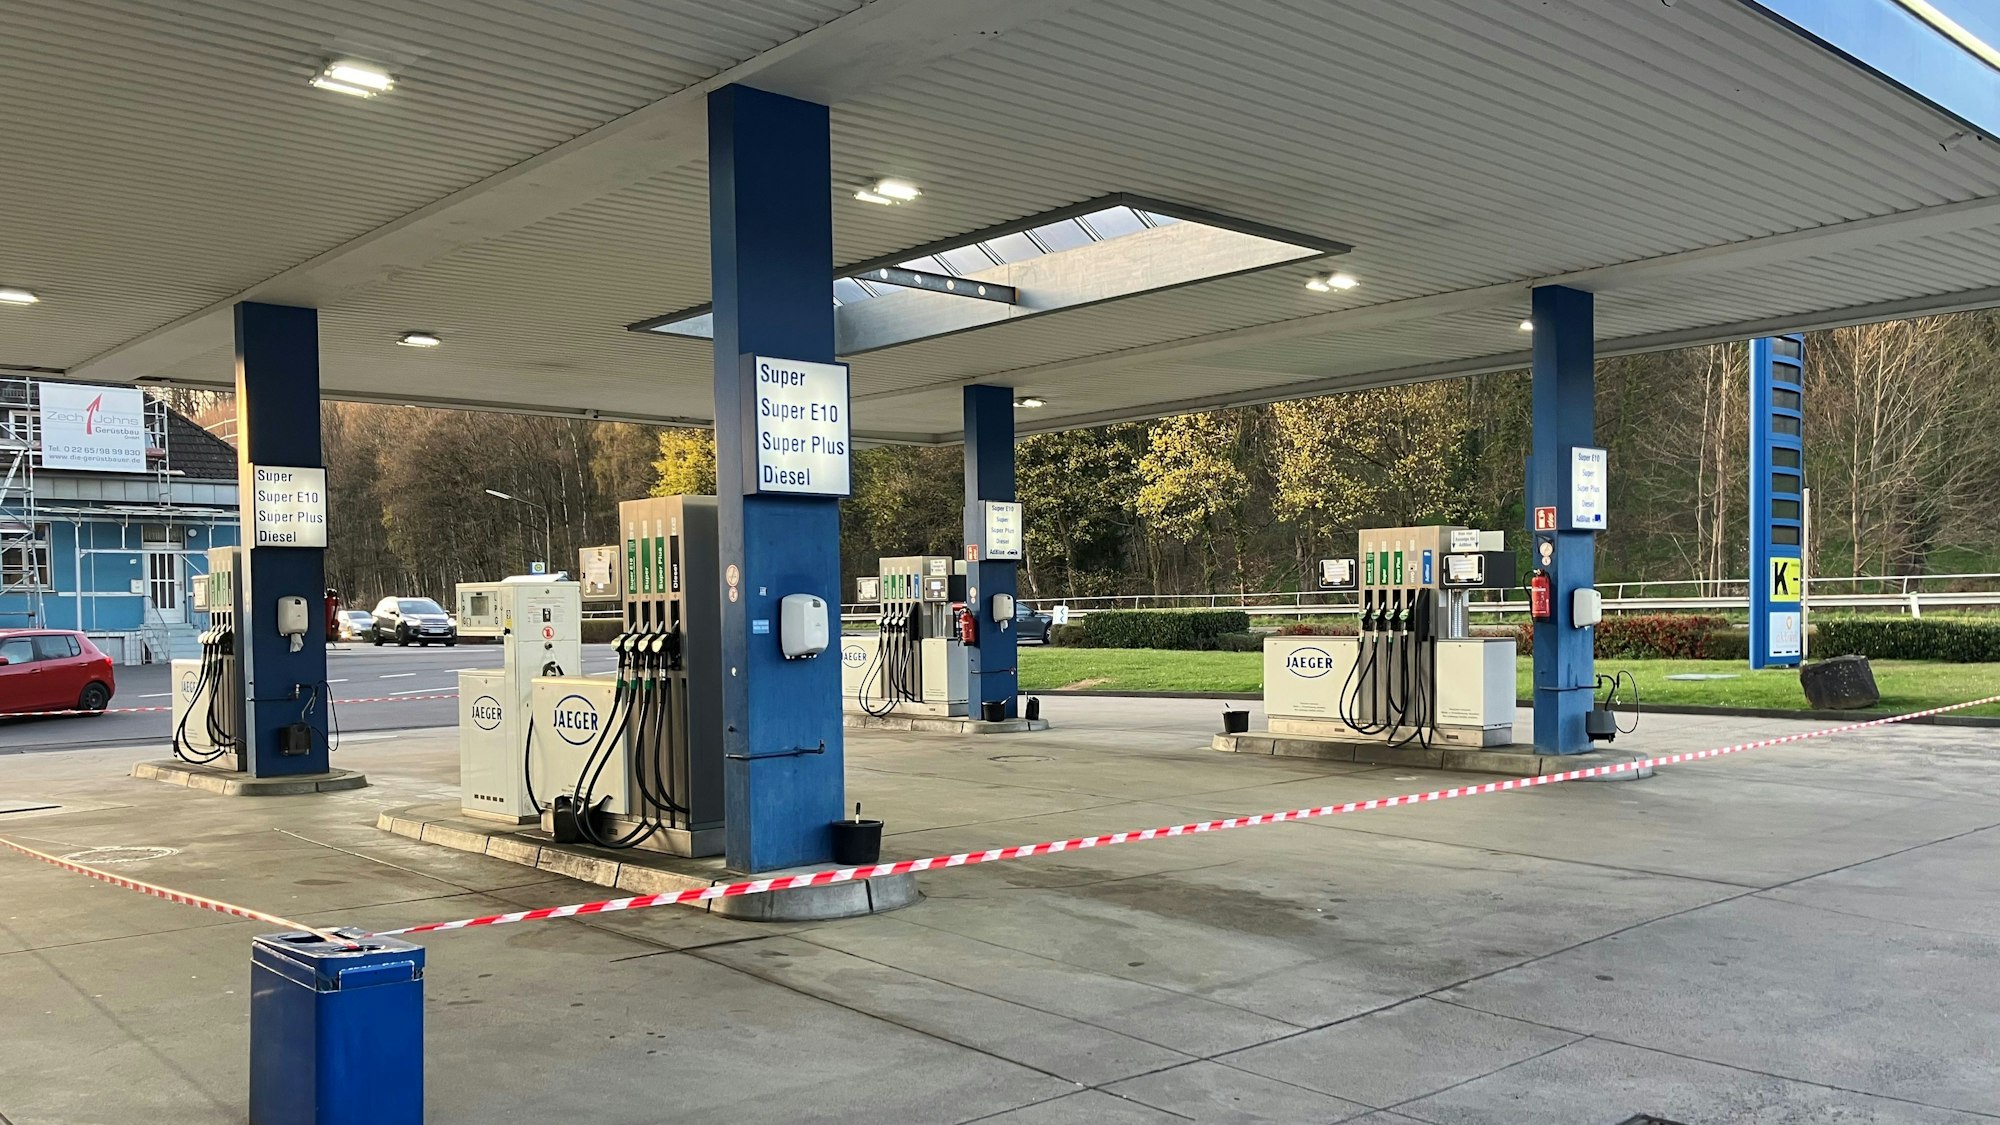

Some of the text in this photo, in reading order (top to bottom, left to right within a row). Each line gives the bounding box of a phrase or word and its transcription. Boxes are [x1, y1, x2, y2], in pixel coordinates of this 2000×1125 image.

[761, 364, 805, 388] Super
[762, 398, 838, 422] Super E10
[47, 411, 139, 425] Zech Johns
[96, 427, 139, 435] Gerüstbau
[762, 432, 844, 455] Super Plus
[258, 470, 292, 484] Super
[764, 465, 810, 485] Diesel
[258, 490, 318, 504] Super E10
[259, 510, 323, 524] Super Plus
[260, 530, 296, 542] Diesel
[1286, 656, 1332, 669] JAEGER
[472, 706, 502, 720] JAEGER
[554, 710, 598, 730] JAEGER
